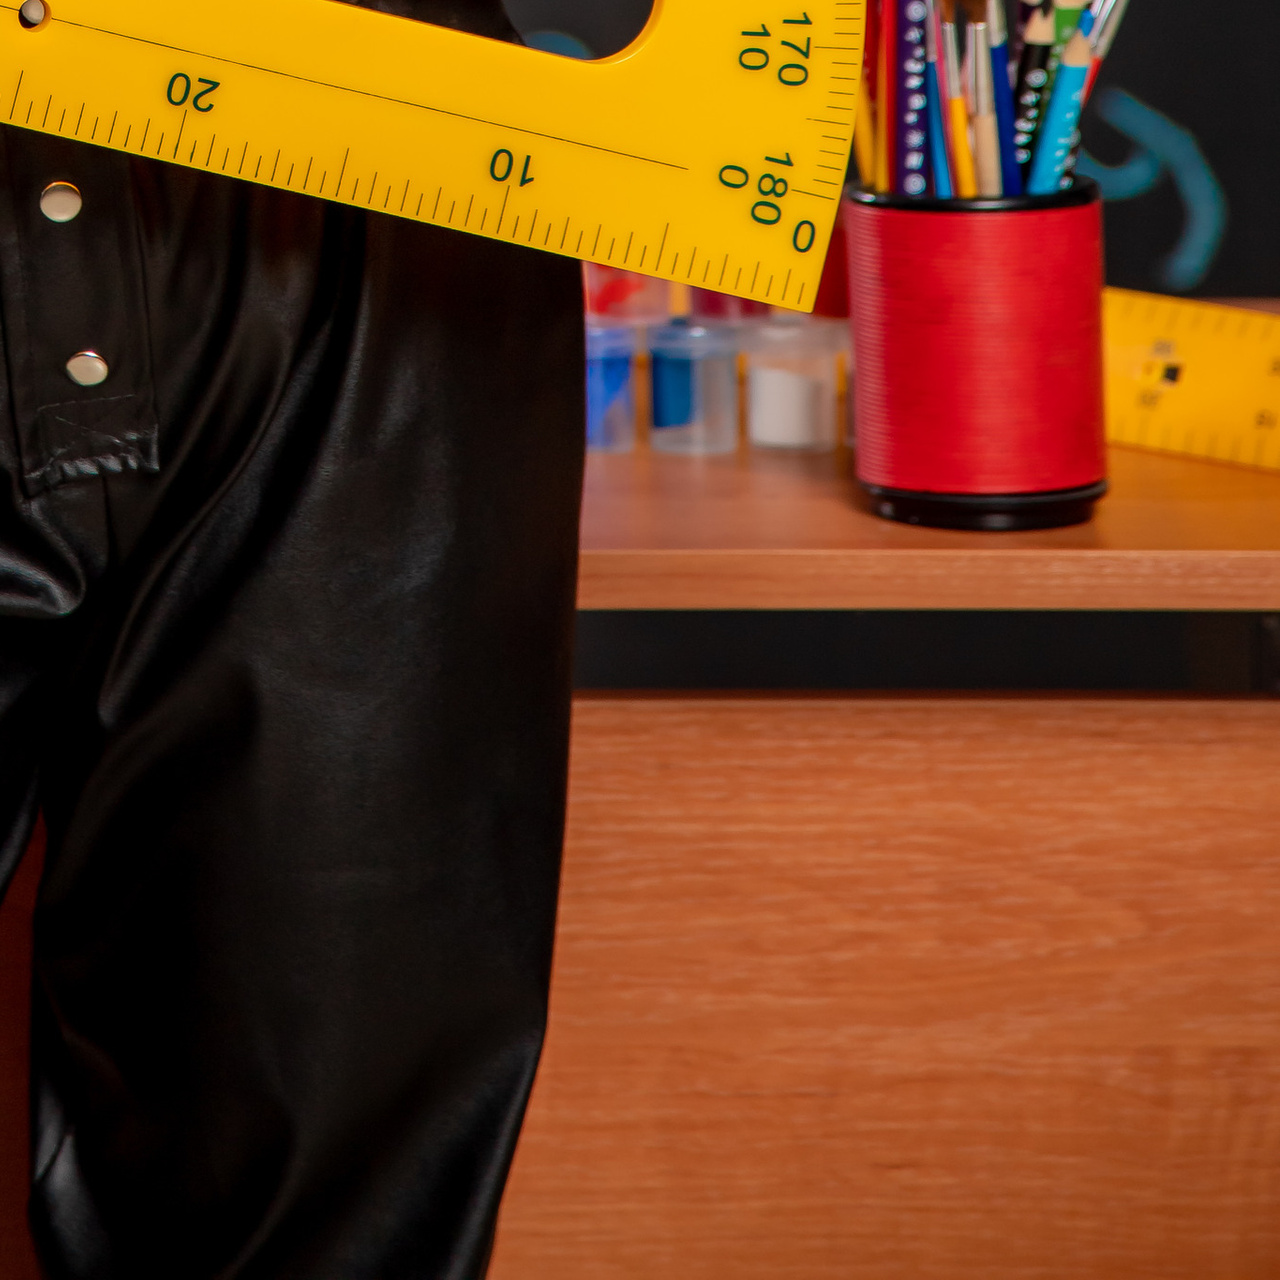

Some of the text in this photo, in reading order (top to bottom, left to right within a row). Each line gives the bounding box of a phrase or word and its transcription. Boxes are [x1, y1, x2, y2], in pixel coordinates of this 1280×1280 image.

[738, 23, 770, 70] 10
[777, 12, 812, 86] 170
[166, 72, 220, 112] 20
[489, 148, 534, 186] 10
[718, 164, 749, 189] 0
[750, 152, 793, 225] 180
[792, 219, 815, 253] 0
